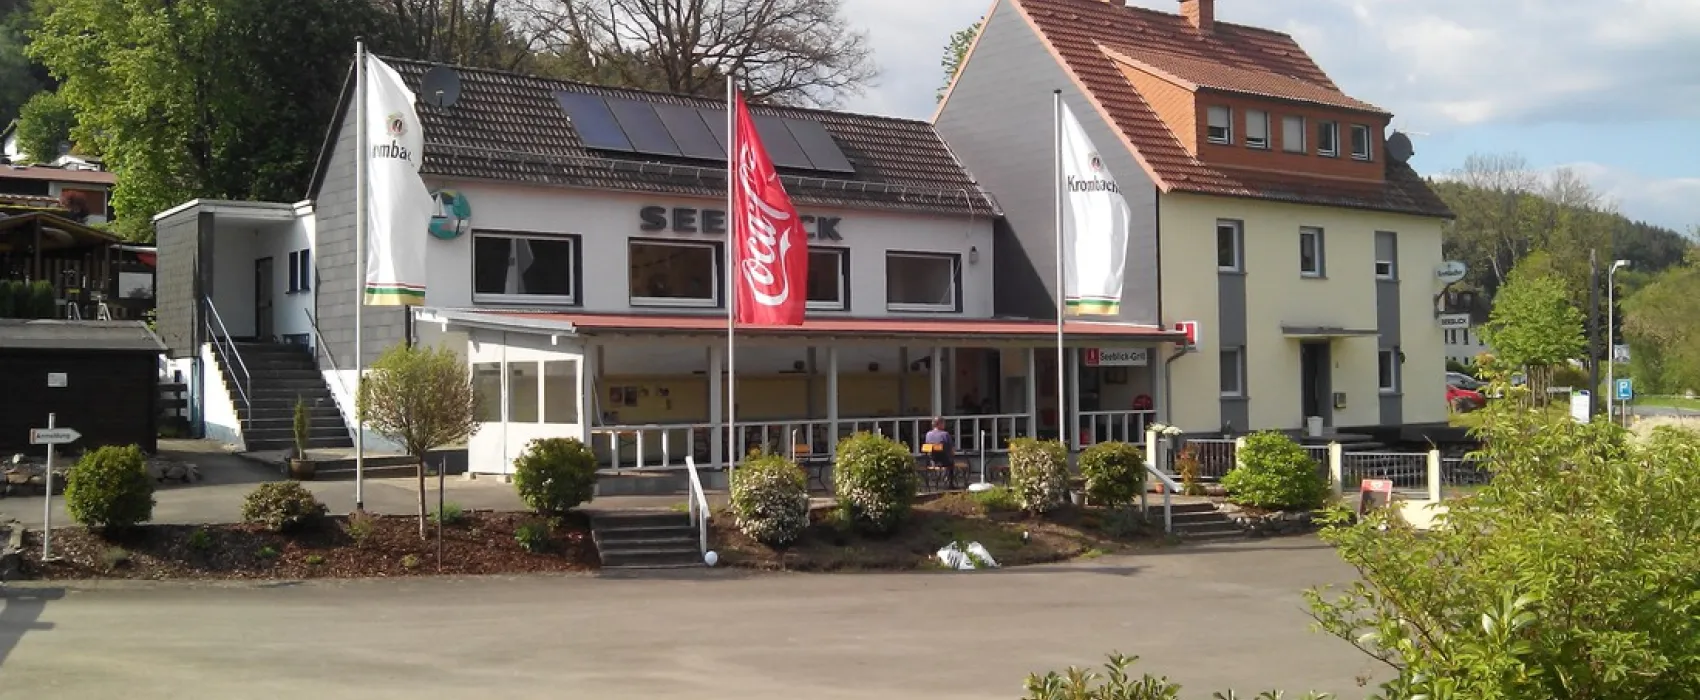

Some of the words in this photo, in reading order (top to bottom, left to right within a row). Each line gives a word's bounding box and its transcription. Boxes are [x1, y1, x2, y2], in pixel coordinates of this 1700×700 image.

[1067, 174, 1123, 195] Krombach
[639, 205, 843, 242] SEECK
[1100, 351, 1146, 362] Seeblick-Grill
[1619, 381, 1628, 395] P
